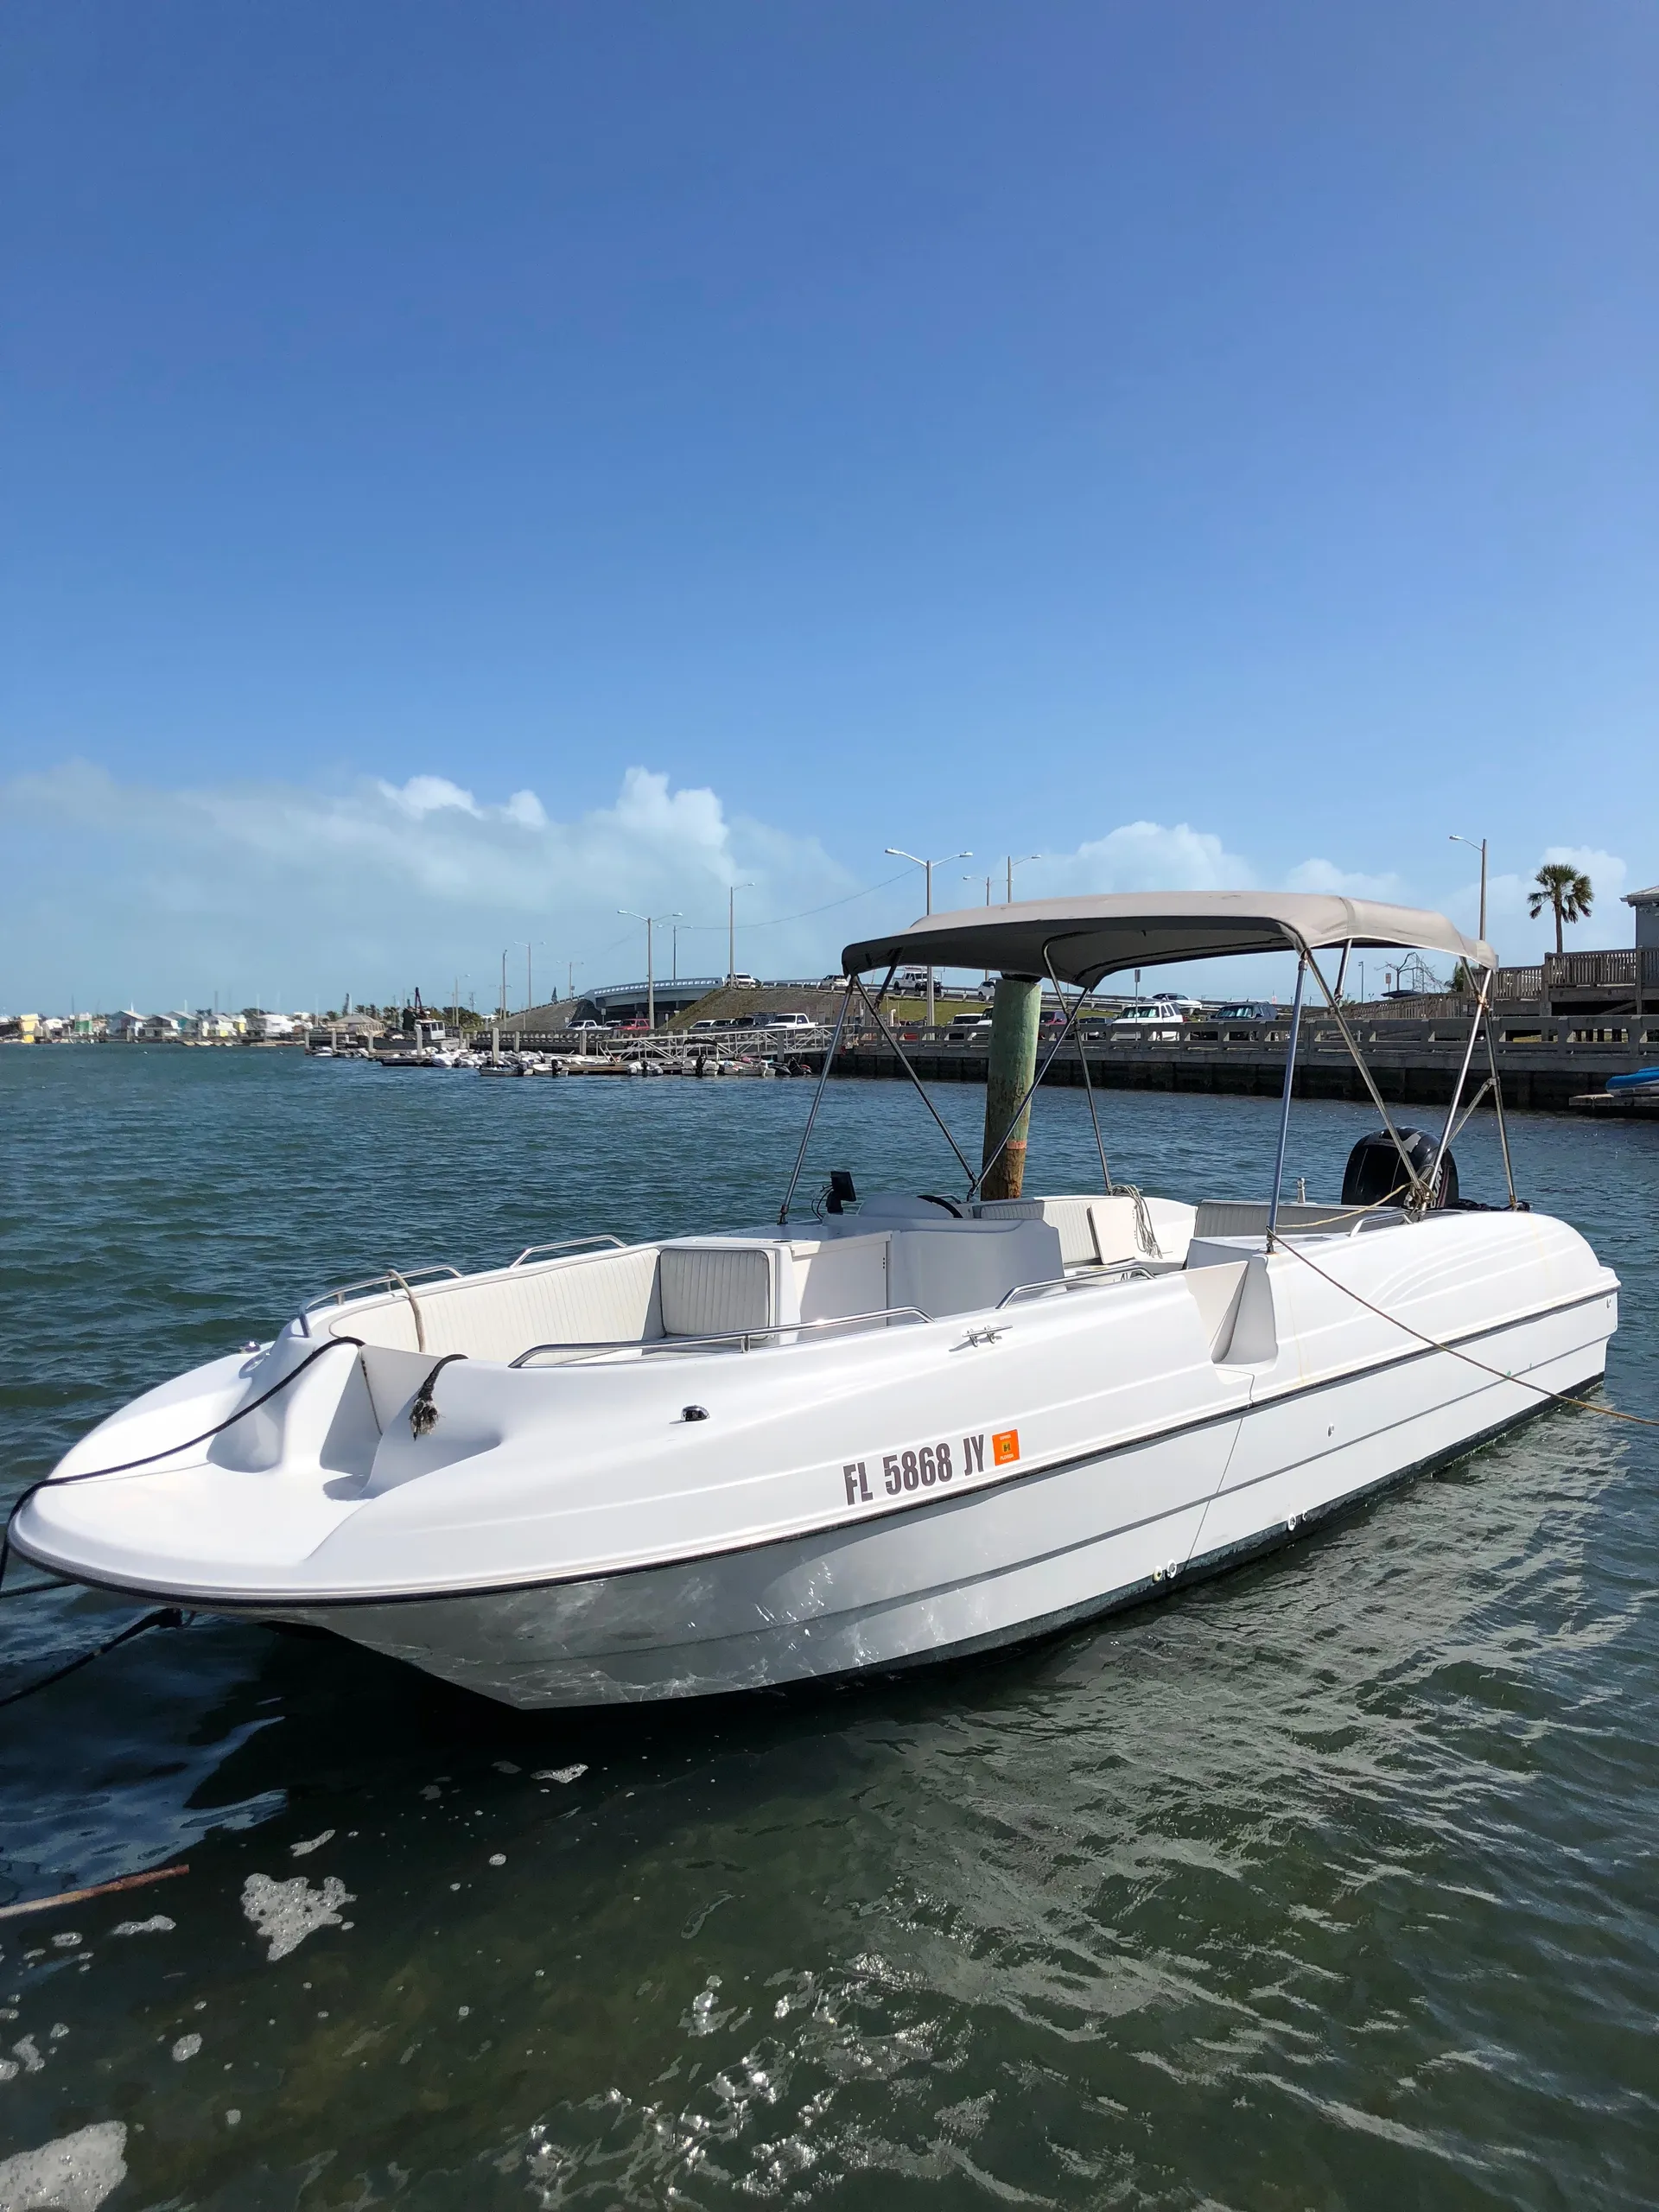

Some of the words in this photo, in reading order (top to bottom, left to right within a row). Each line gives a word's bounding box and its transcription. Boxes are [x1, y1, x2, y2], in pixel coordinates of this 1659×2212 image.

[843, 1462, 873, 1505] FL
[882, 1443, 952, 1495] 5868
[963, 1434, 984, 1476] JY
